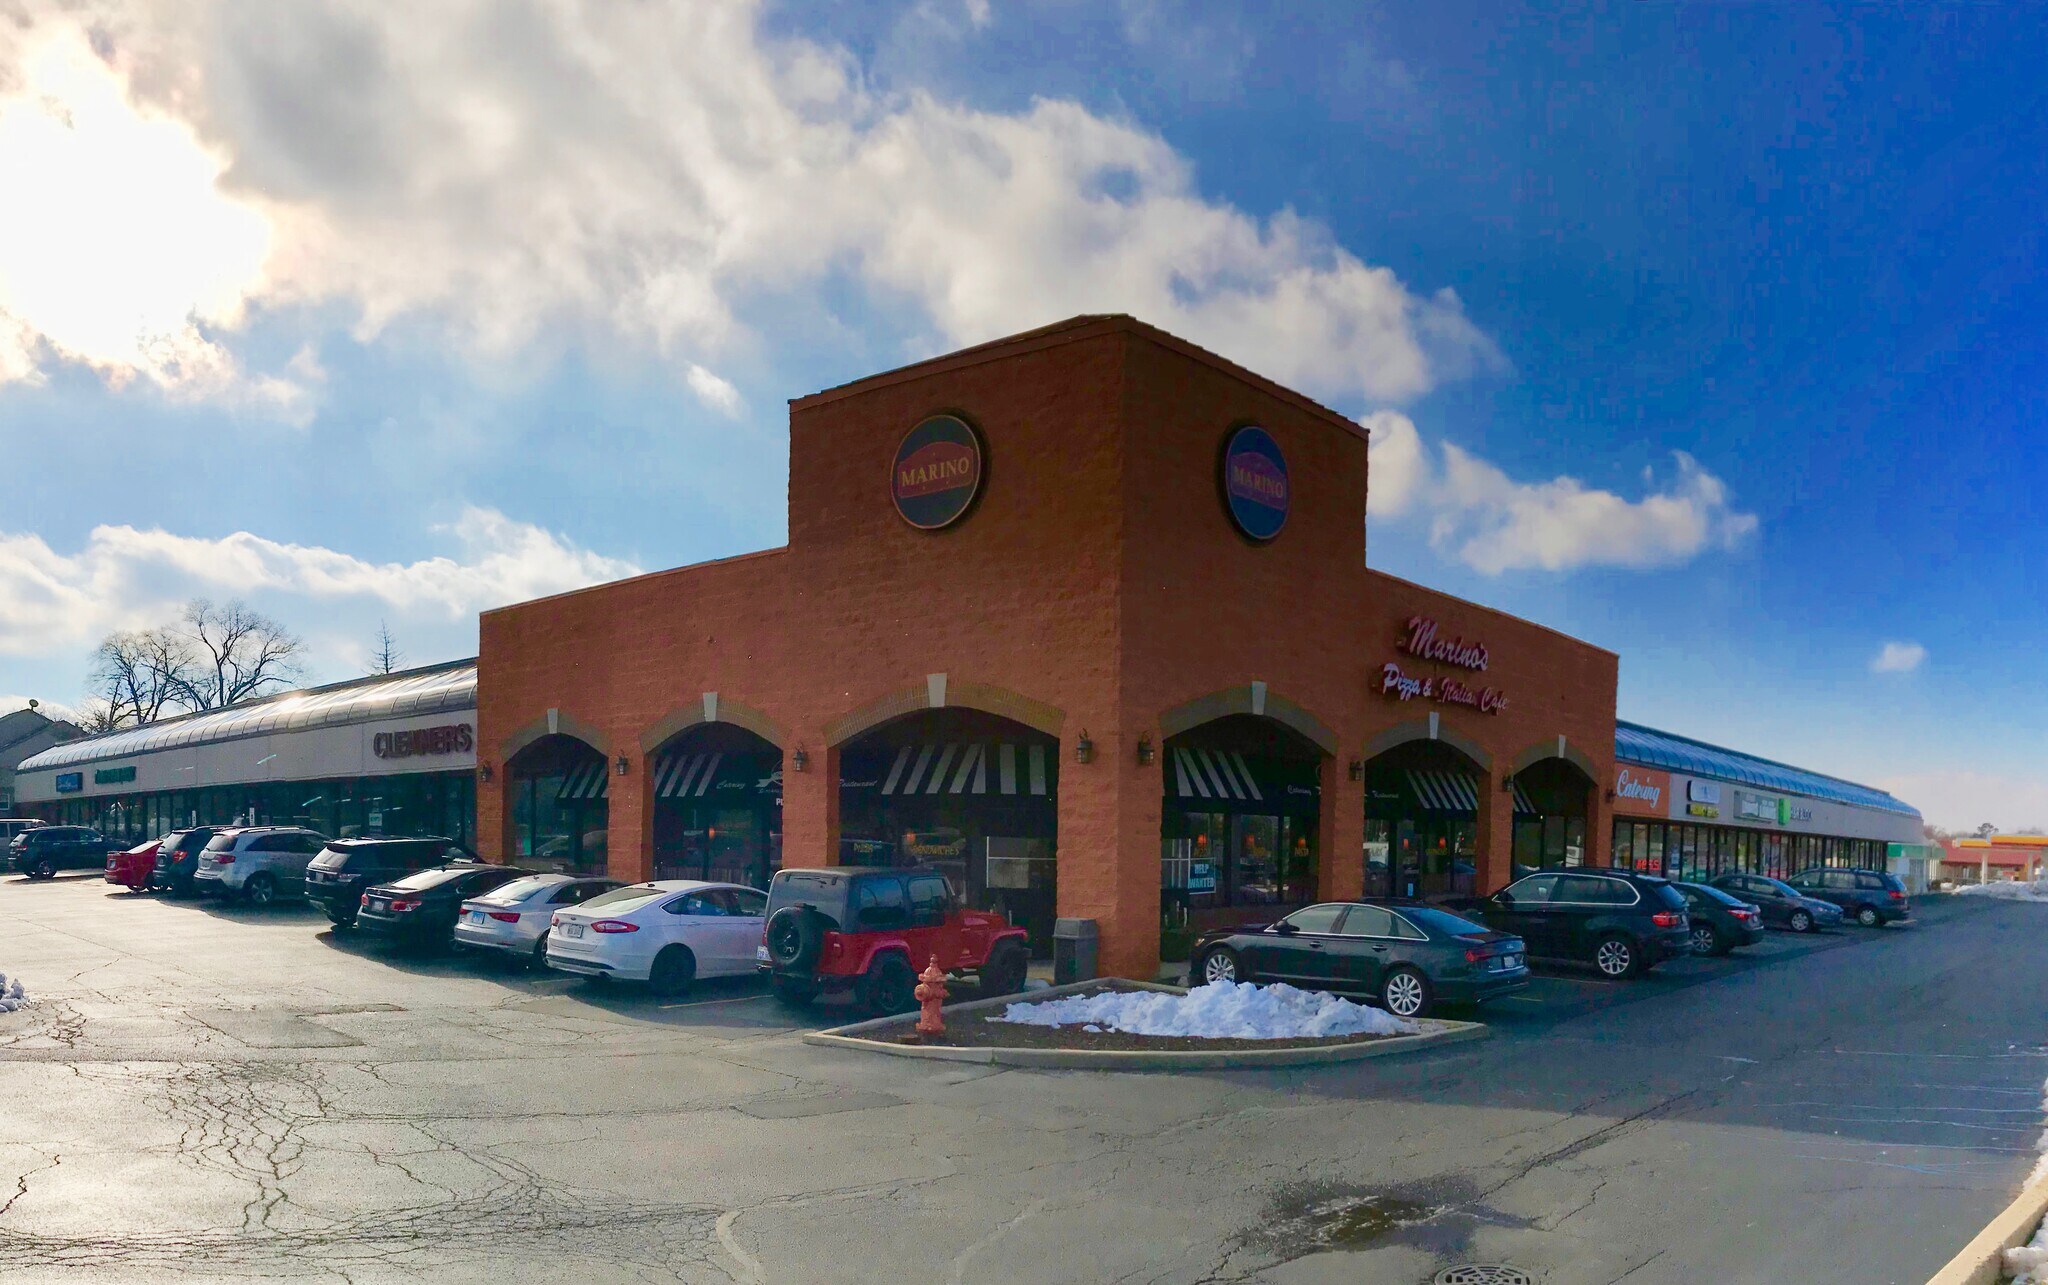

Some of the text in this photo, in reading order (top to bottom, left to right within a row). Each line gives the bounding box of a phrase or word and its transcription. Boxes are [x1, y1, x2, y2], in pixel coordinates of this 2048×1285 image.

[901, 457, 970, 487] MARINO
[1231, 464, 1284, 498] MARINO
[1408, 615, 1489, 671] Marino's
[1382, 662, 1420, 701] Pizza
[1423, 678, 1432, 697] &
[373, 723, 473, 759] CLEANERS
[1616, 769, 1661, 808] Catering
[1189, 877, 1215, 889] WANTED
[1194, 863, 1209, 874] HELP
